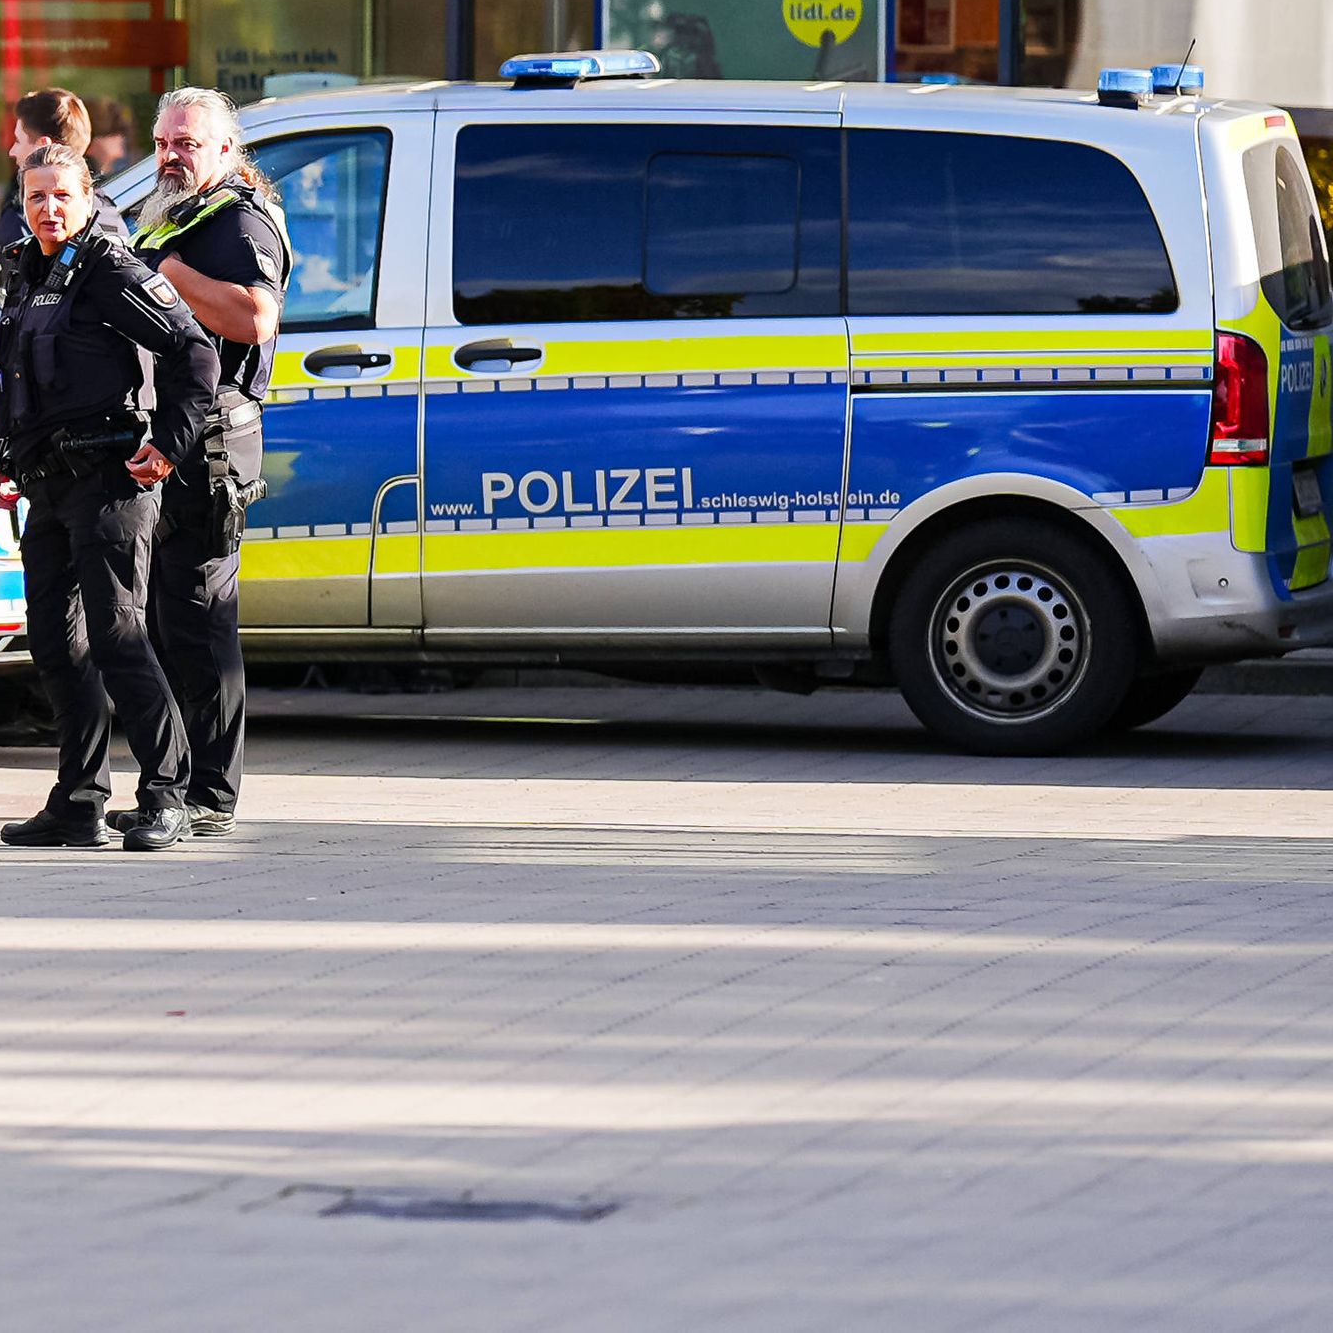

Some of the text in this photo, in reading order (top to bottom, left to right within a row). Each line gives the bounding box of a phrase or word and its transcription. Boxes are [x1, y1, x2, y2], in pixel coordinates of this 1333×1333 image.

[789, 2, 856, 22] lidl.de
[31, 293, 63, 308] POLIZEI
[1280, 361, 1312, 394] POLIZEI
[430, 503, 478, 517] www.
[482, 467, 694, 515] POLIZEI
